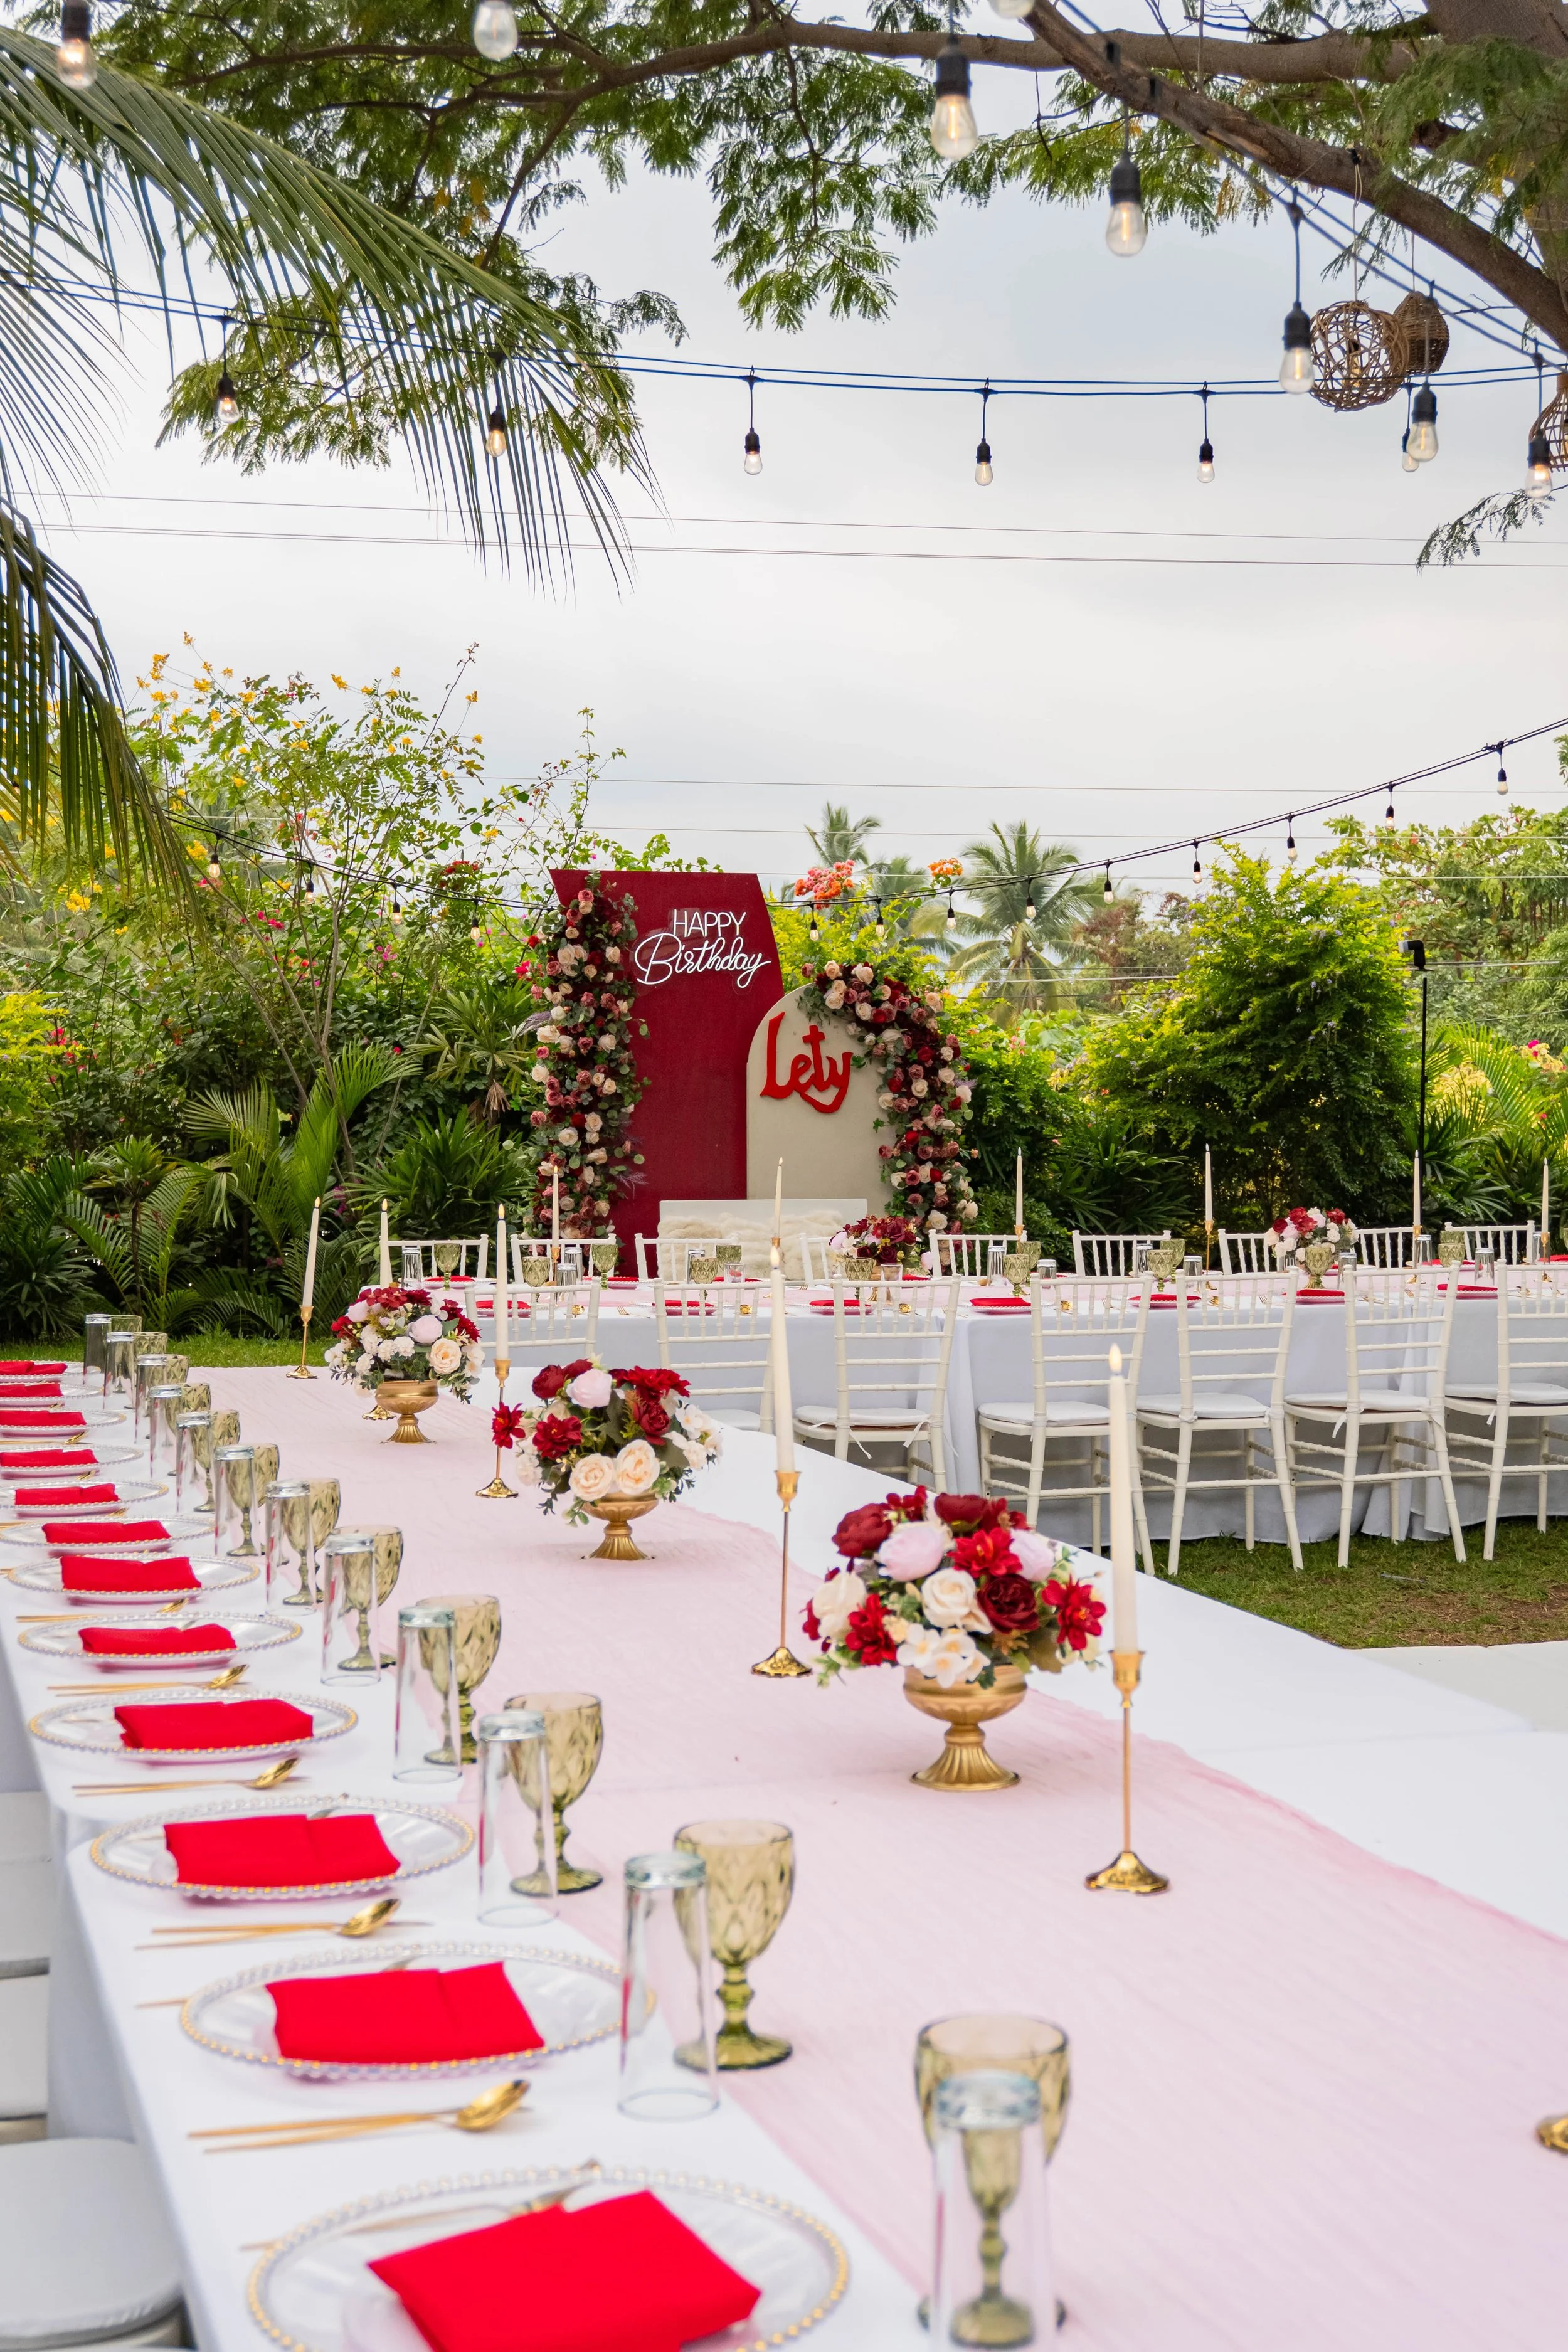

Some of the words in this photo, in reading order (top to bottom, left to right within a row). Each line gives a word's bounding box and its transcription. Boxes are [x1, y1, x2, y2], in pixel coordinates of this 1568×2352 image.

[673, 909, 746, 937] HAPPY
[634, 933, 771, 988] Birthday
[759, 1012, 853, 1113] Lety
